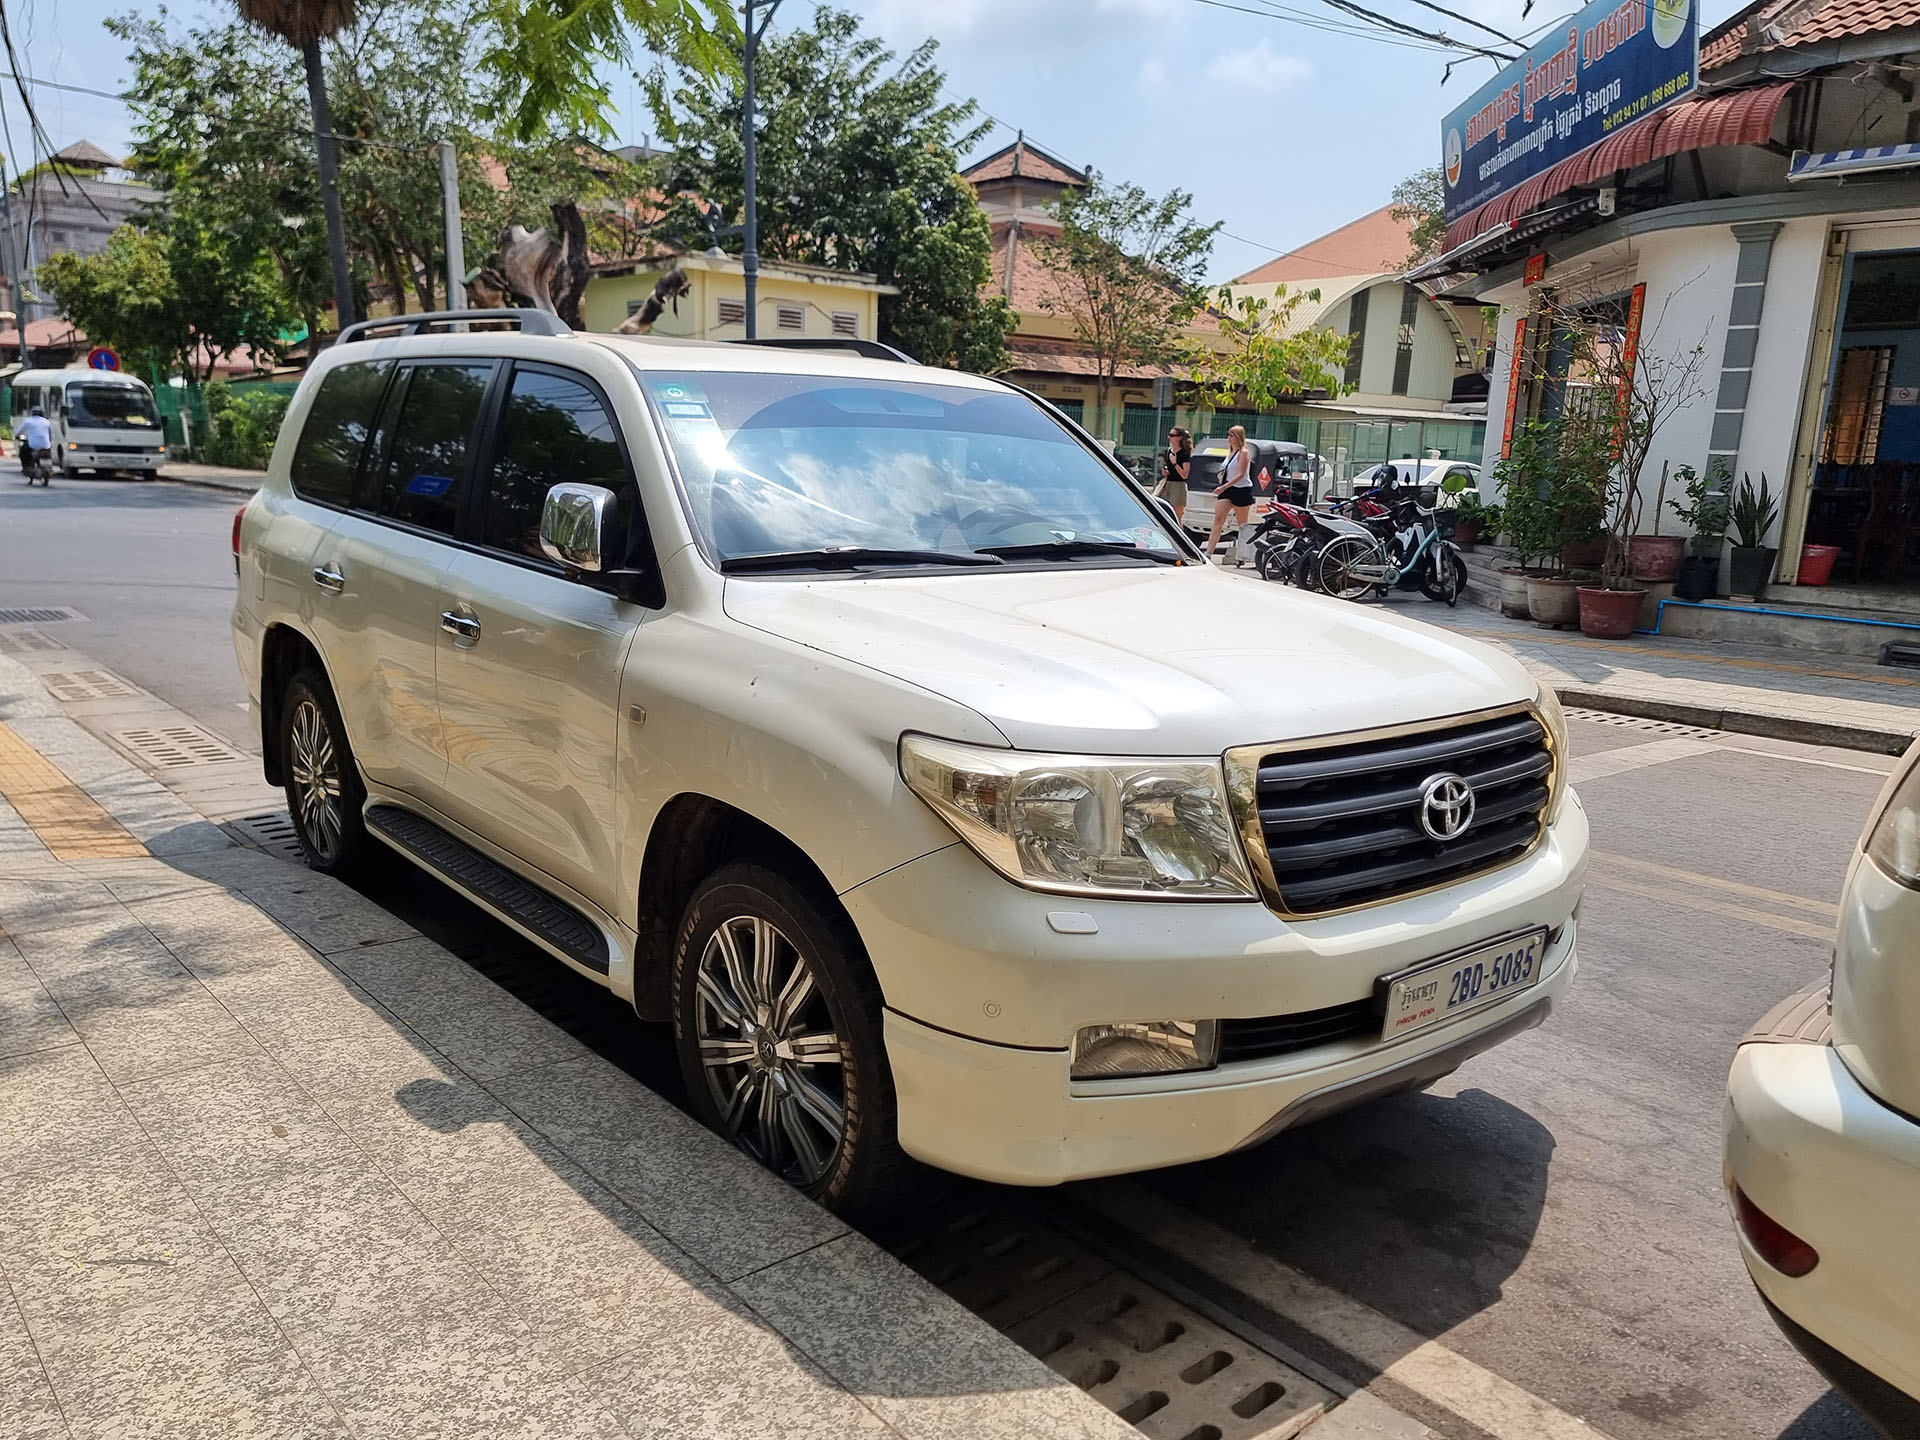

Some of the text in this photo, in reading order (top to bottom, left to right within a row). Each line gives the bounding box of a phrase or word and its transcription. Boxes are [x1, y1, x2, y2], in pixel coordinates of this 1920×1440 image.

[1612, 109, 1623, 126] 012
[1623, 104, 1631, 120] 94
[1632, 99, 1639, 115] 31
[1639, 95, 1648, 111] 07
[1447, 944, 1536, 1007] 2BD-5085
[1401, 981, 1438, 1011] ភ្នំពេញ
[1395, 1007, 1436, 1027] PHNOM PENH
